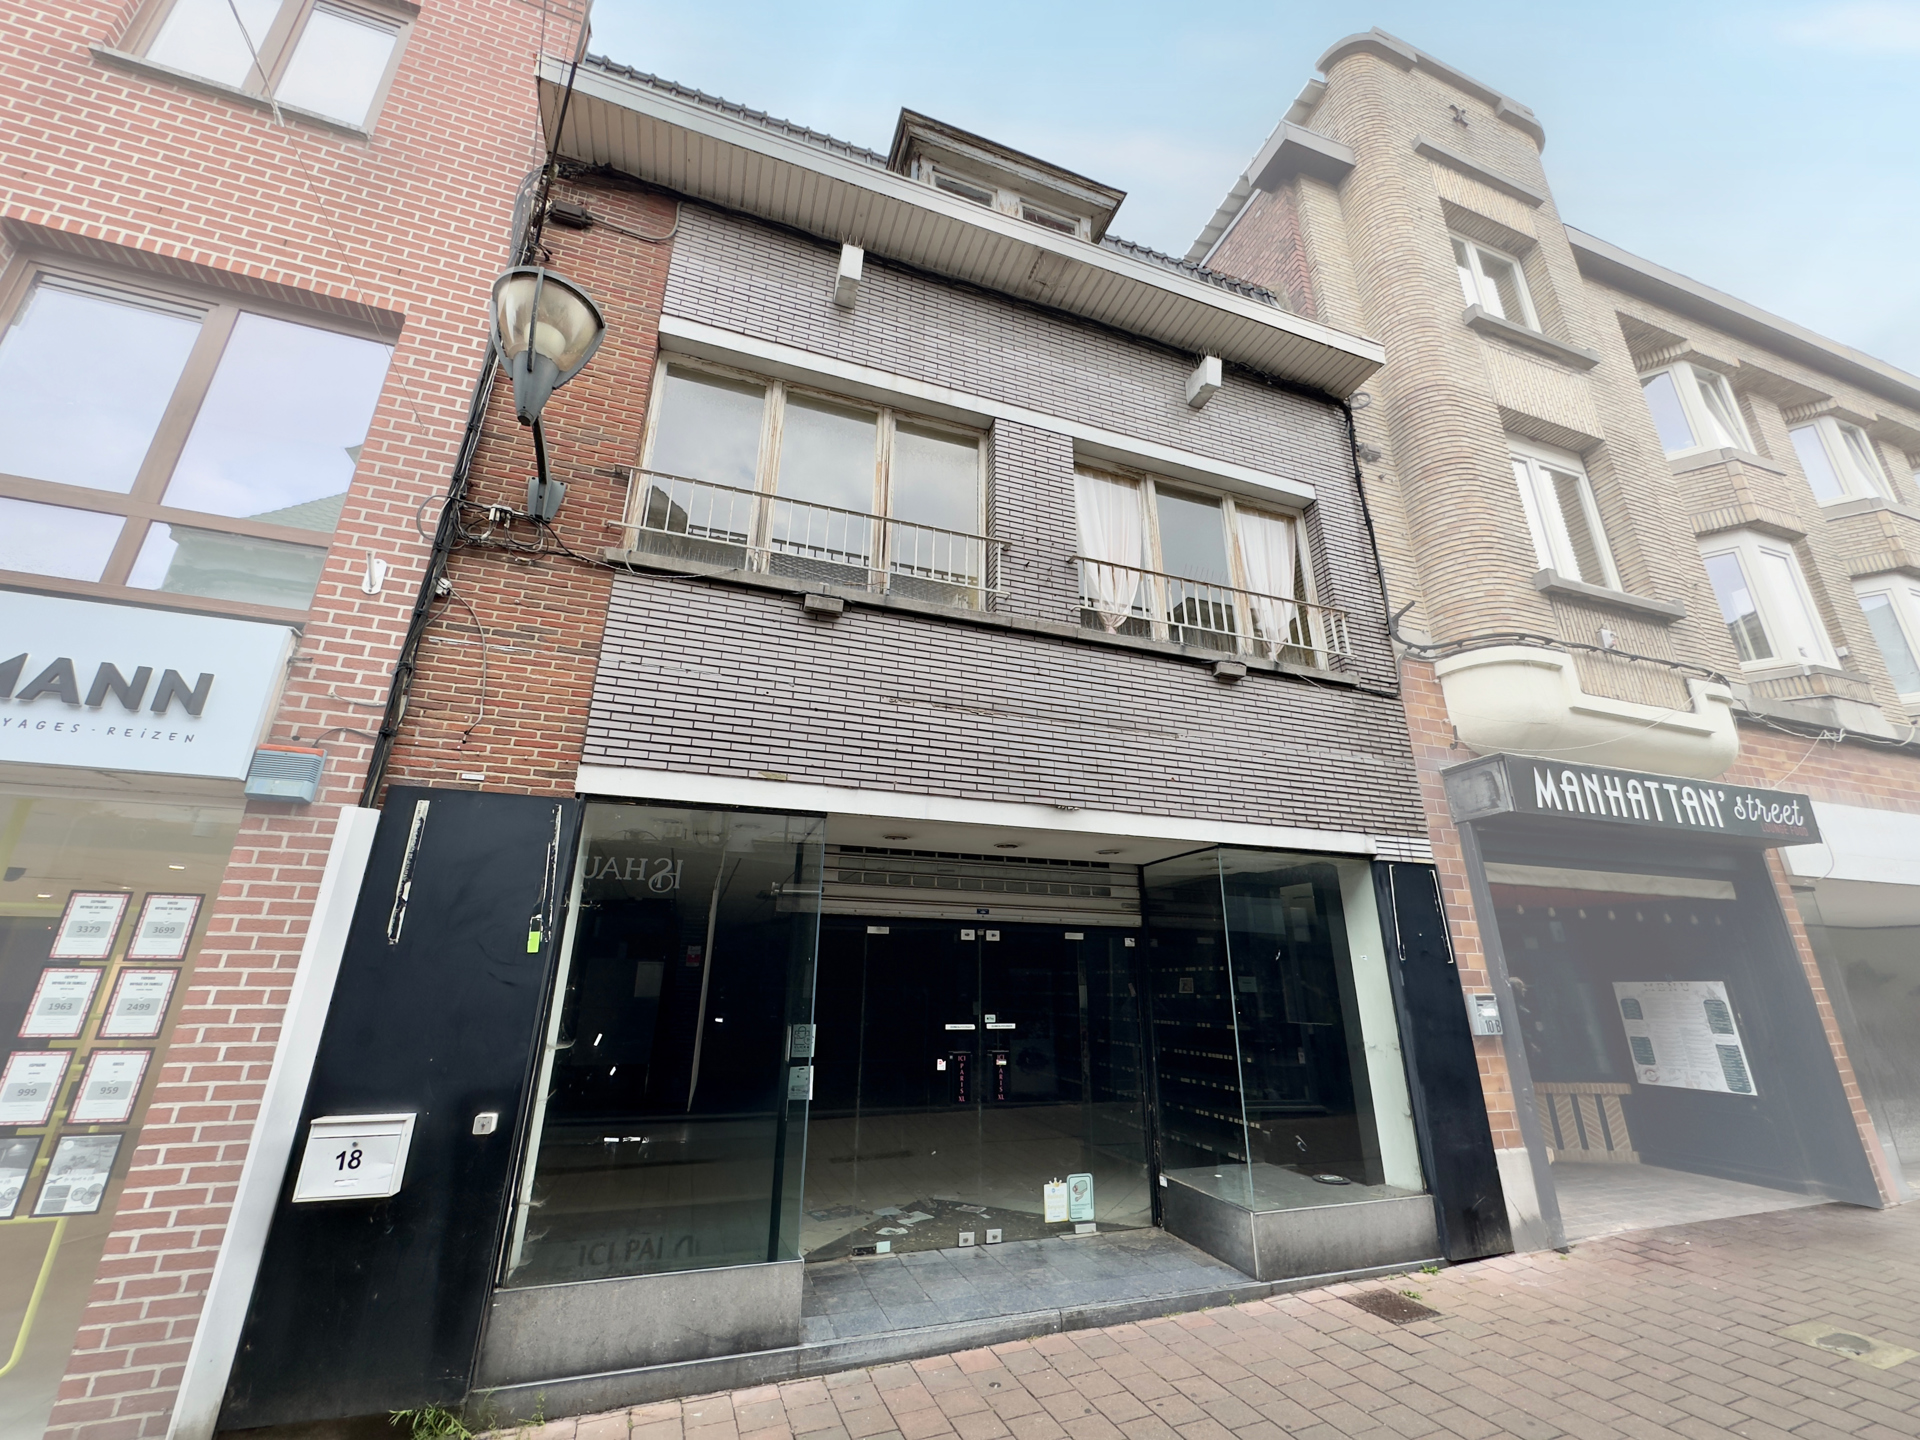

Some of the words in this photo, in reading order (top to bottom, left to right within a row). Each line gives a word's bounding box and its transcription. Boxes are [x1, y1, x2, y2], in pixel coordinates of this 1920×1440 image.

[1734, 794, 1804, 826] street
[152, 926, 176, 934] 3699
[126, 1003, 150, 1011] 2499
[336, 1149, 363, 1171] 18
